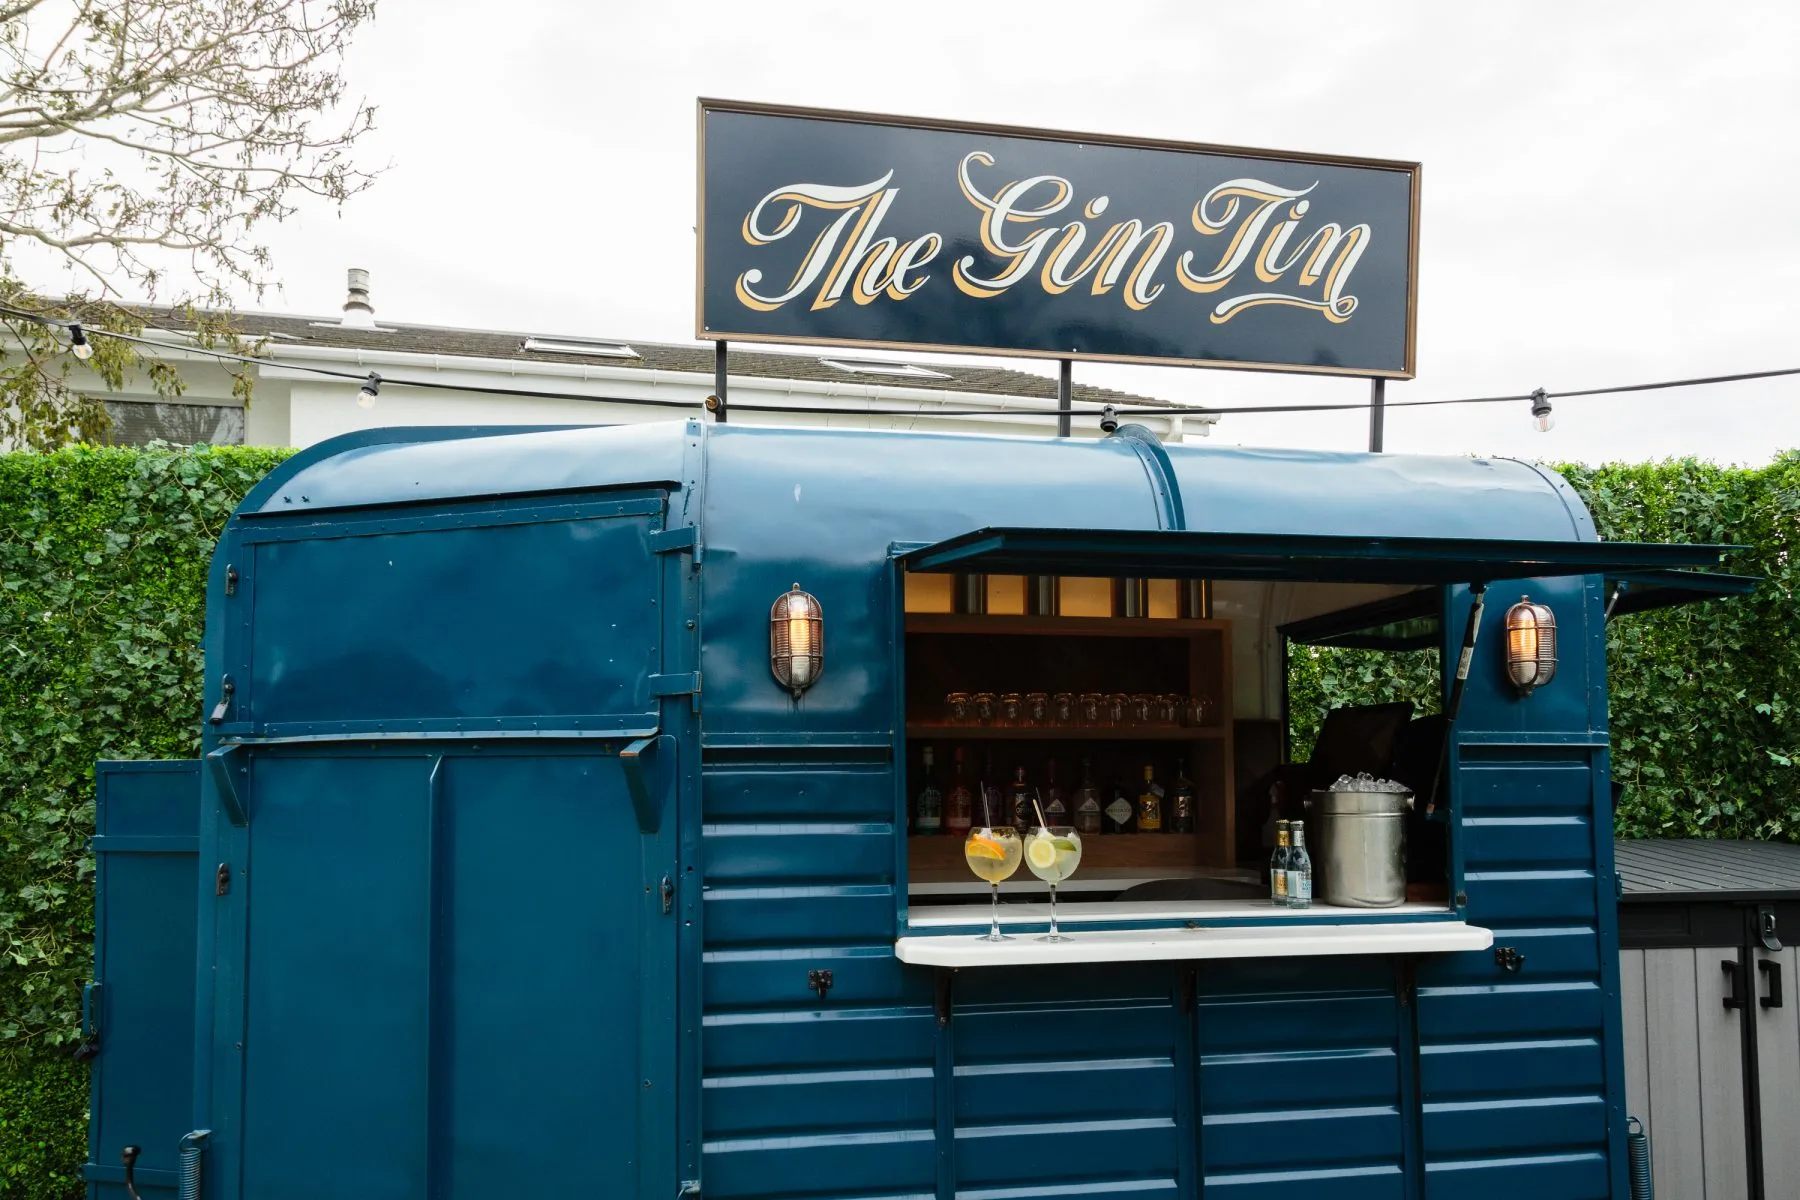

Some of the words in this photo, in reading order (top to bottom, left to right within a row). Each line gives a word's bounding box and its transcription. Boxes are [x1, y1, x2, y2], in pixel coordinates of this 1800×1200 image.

[736, 168, 942, 312] The
[953, 150, 1174, 311] Gin
[1176, 177, 1371, 324] Tin
